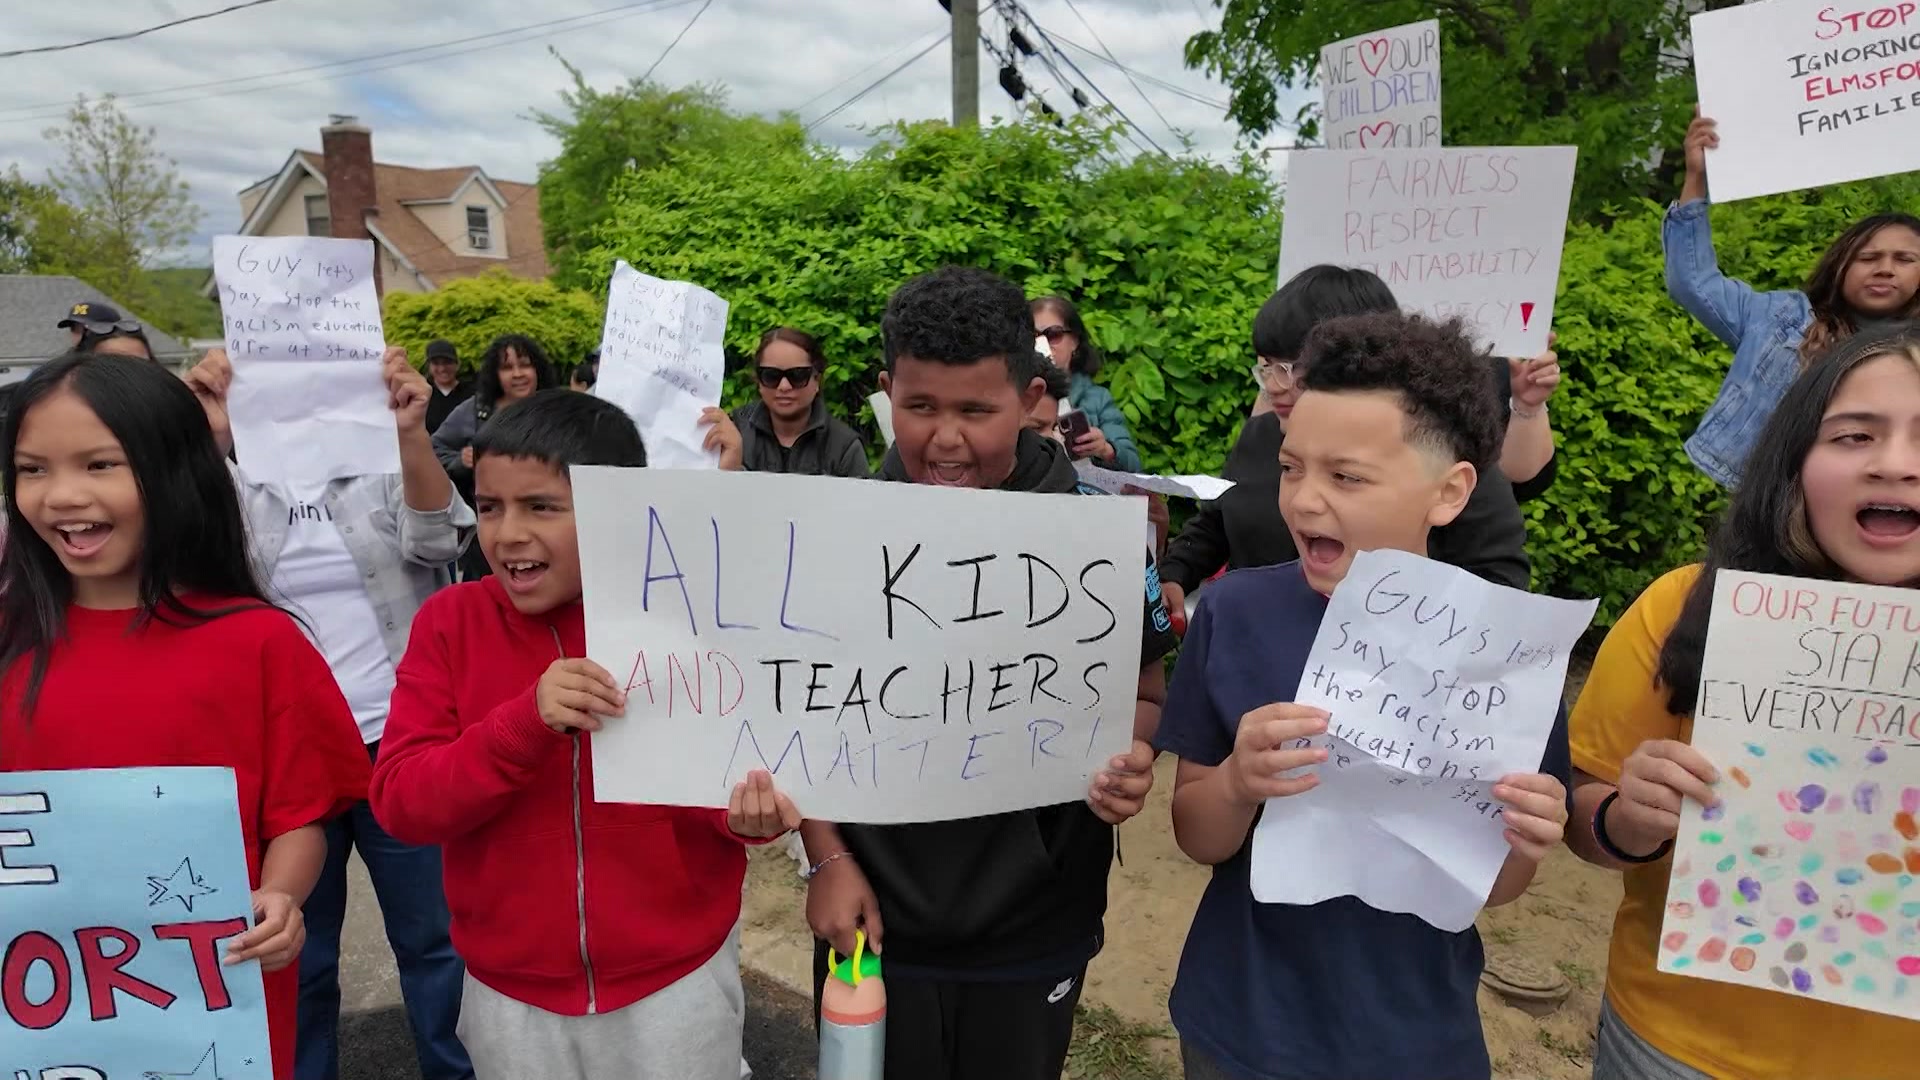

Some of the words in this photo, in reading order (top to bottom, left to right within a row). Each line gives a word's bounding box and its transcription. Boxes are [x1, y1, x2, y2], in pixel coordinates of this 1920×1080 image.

[1815, 3, 1916, 40] STOP
[1325, 45, 1357, 85] WE
[1390, 29, 1438, 71] OUR
[1326, 71, 1440, 124] CHILDREN
[1348, 154, 1520, 200] FAIRNESS
[1344, 206, 1488, 255] RESPECT
[72, 304, 90, 315] M
[331, 297, 361, 311] the
[643, 505, 839, 641] ALL
[882, 543, 1116, 644] KIDS
[1733, 580, 1819, 622] OUR
[624, 649, 745, 718] AND
[759, 653, 1109, 734] TEACHERS
[1312, 664, 1363, 702] the
[1378, 693, 1495, 751] racism
[1701, 679, 1853, 733] EVERY
